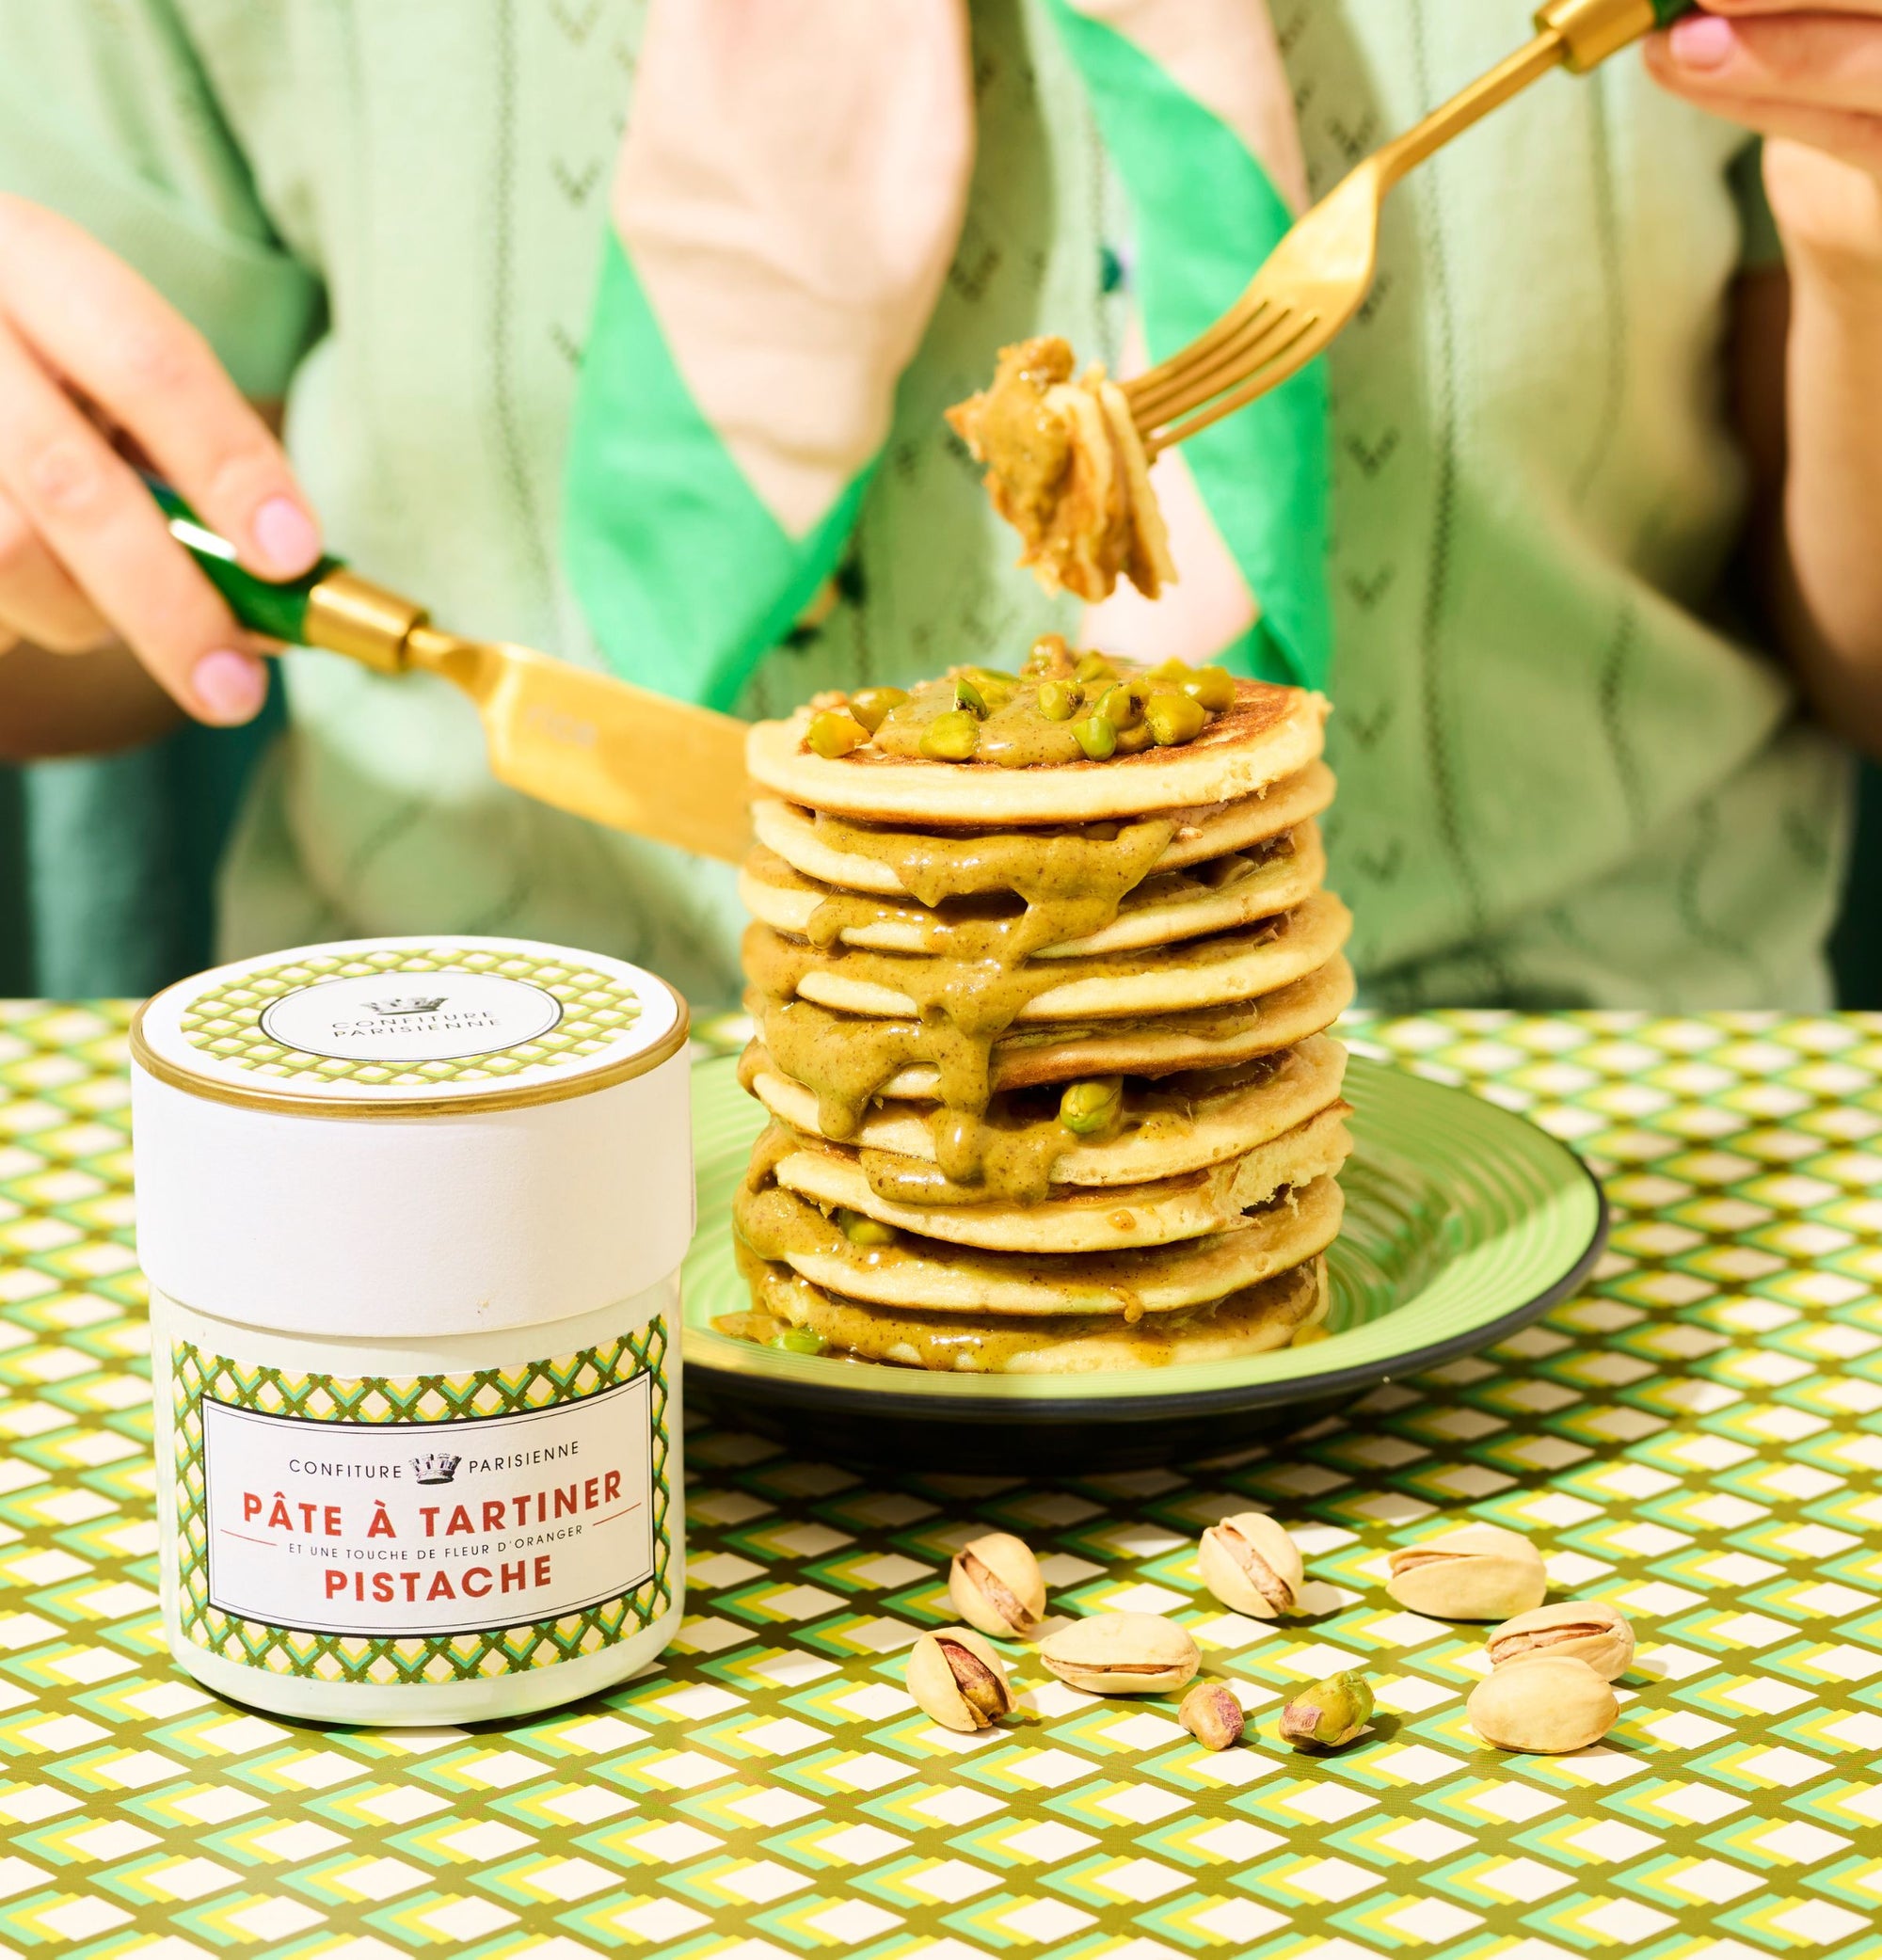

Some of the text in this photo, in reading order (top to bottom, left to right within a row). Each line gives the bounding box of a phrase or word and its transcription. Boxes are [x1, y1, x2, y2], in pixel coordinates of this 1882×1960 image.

[332, 1011, 494, 1029] CONFITURE
[334, 1019, 502, 1038] PARISIENNE
[289, 1441, 581, 1479] CONFITURE PARISIENNE
[244, 1470, 623, 1538] PÂTE À TARTINER
[289, 1524, 583, 1561] ET UNE TOUCHE DE FLEUR D'ORANGER
[325, 1554, 553, 1603] PISTACHE
